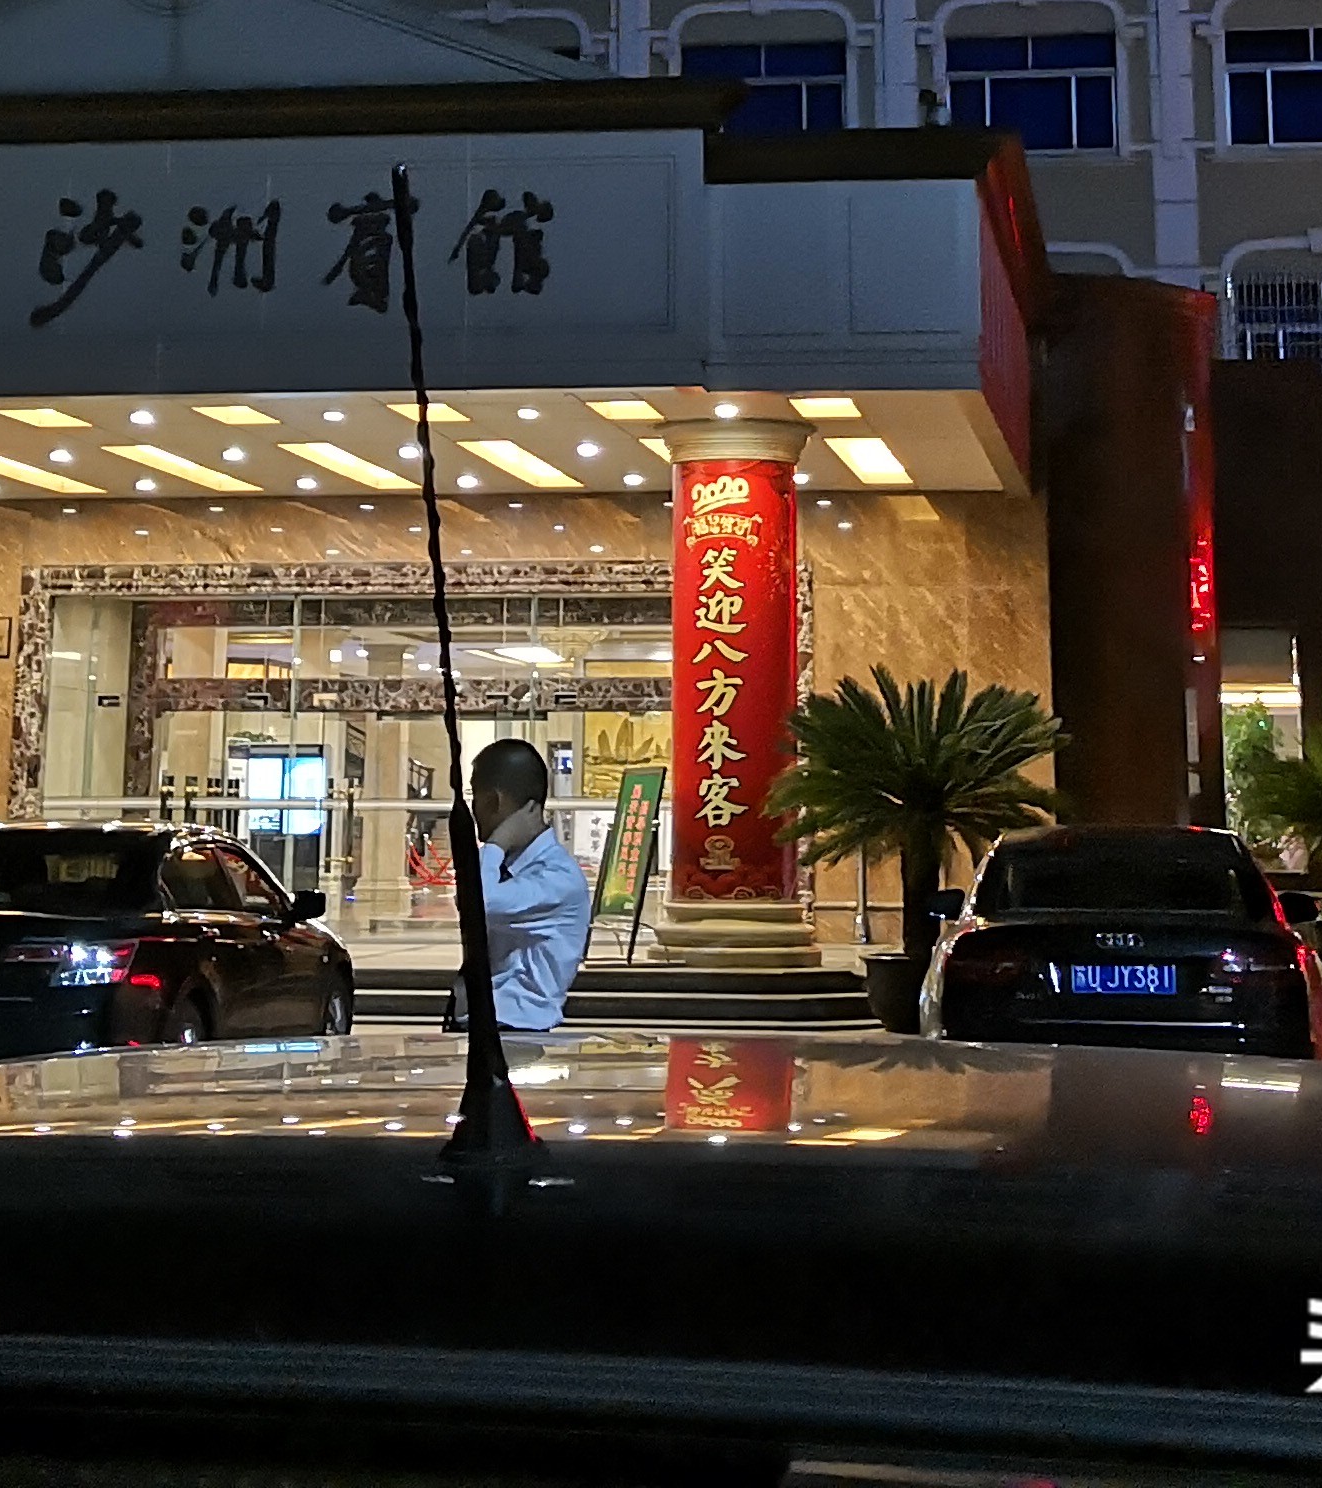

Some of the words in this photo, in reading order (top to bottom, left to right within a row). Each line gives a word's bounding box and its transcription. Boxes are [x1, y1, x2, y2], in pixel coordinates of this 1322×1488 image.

[691, 475, 750, 513] 2020
[692, 547, 750, 828] 笑迎八方來客
